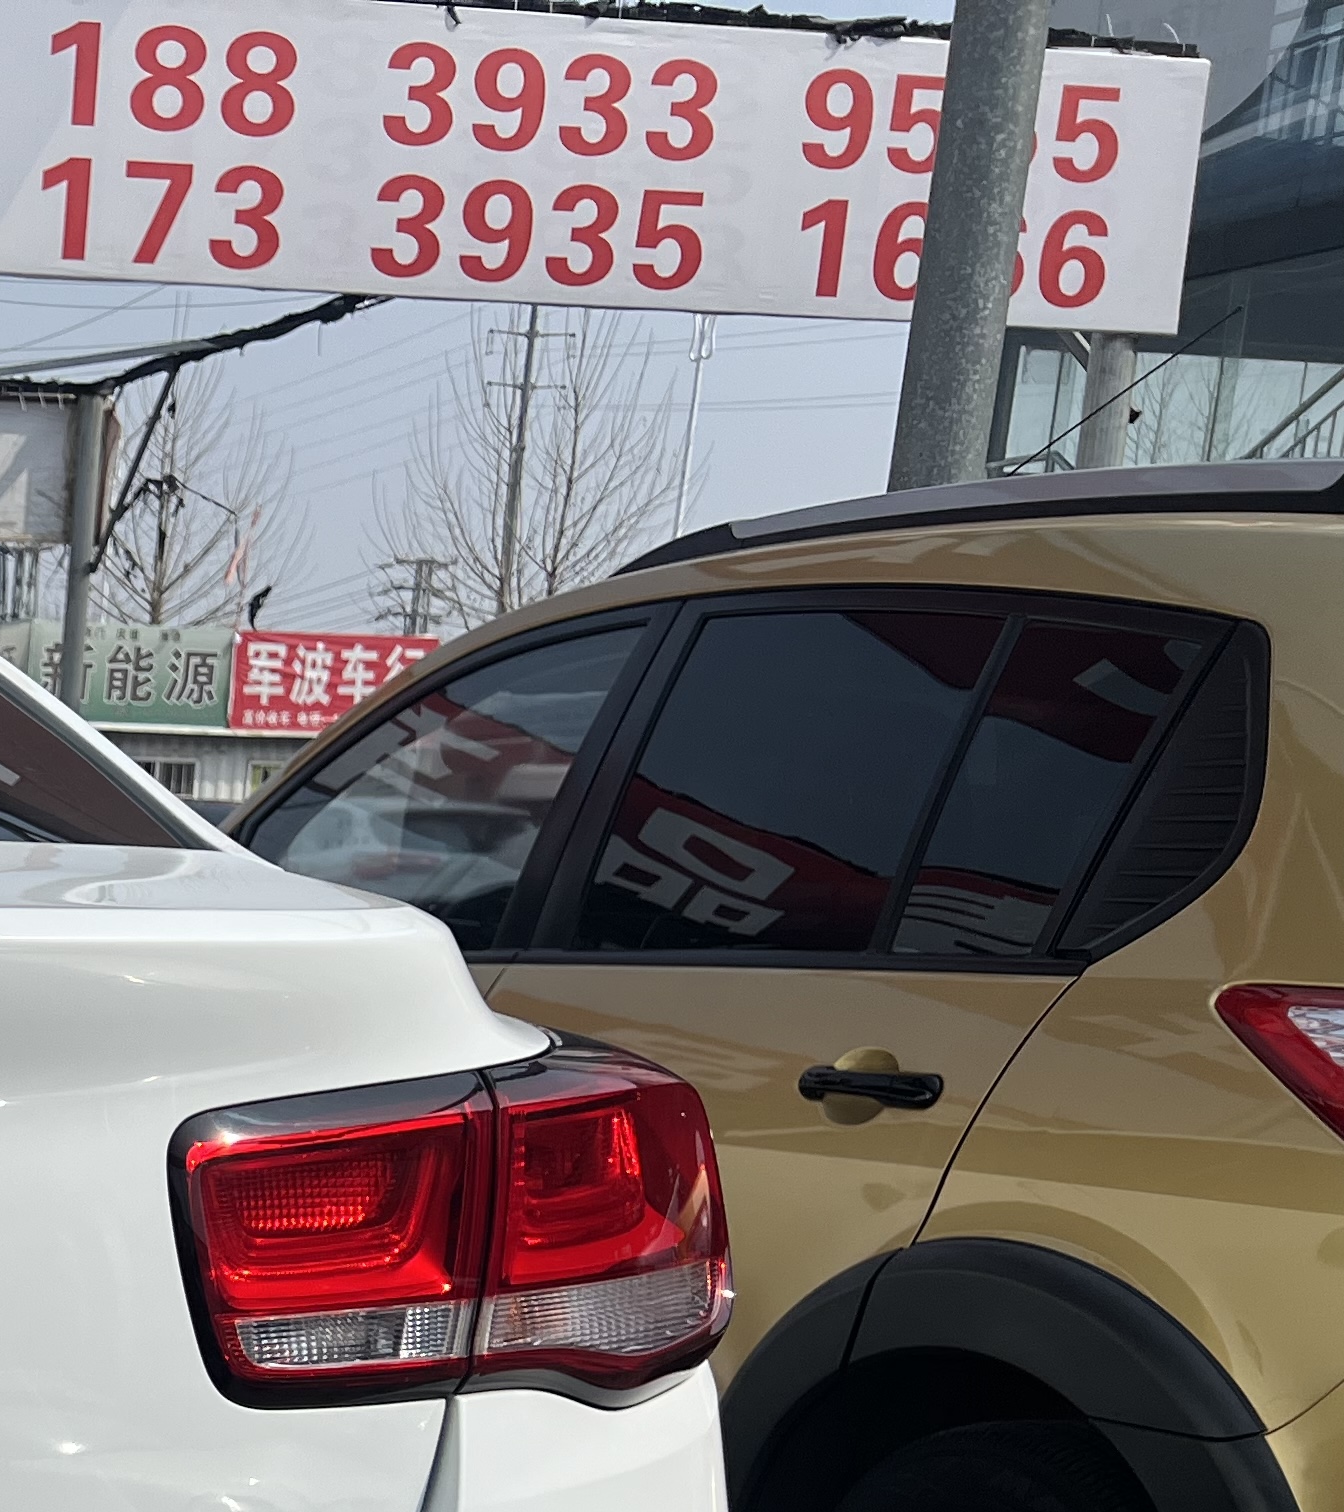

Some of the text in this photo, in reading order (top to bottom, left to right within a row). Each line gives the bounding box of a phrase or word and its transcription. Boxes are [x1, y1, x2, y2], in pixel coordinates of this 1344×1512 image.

[48, 19, 1121, 183] 188 3933 955
[41, 156, 1109, 309] 173 3935 166
